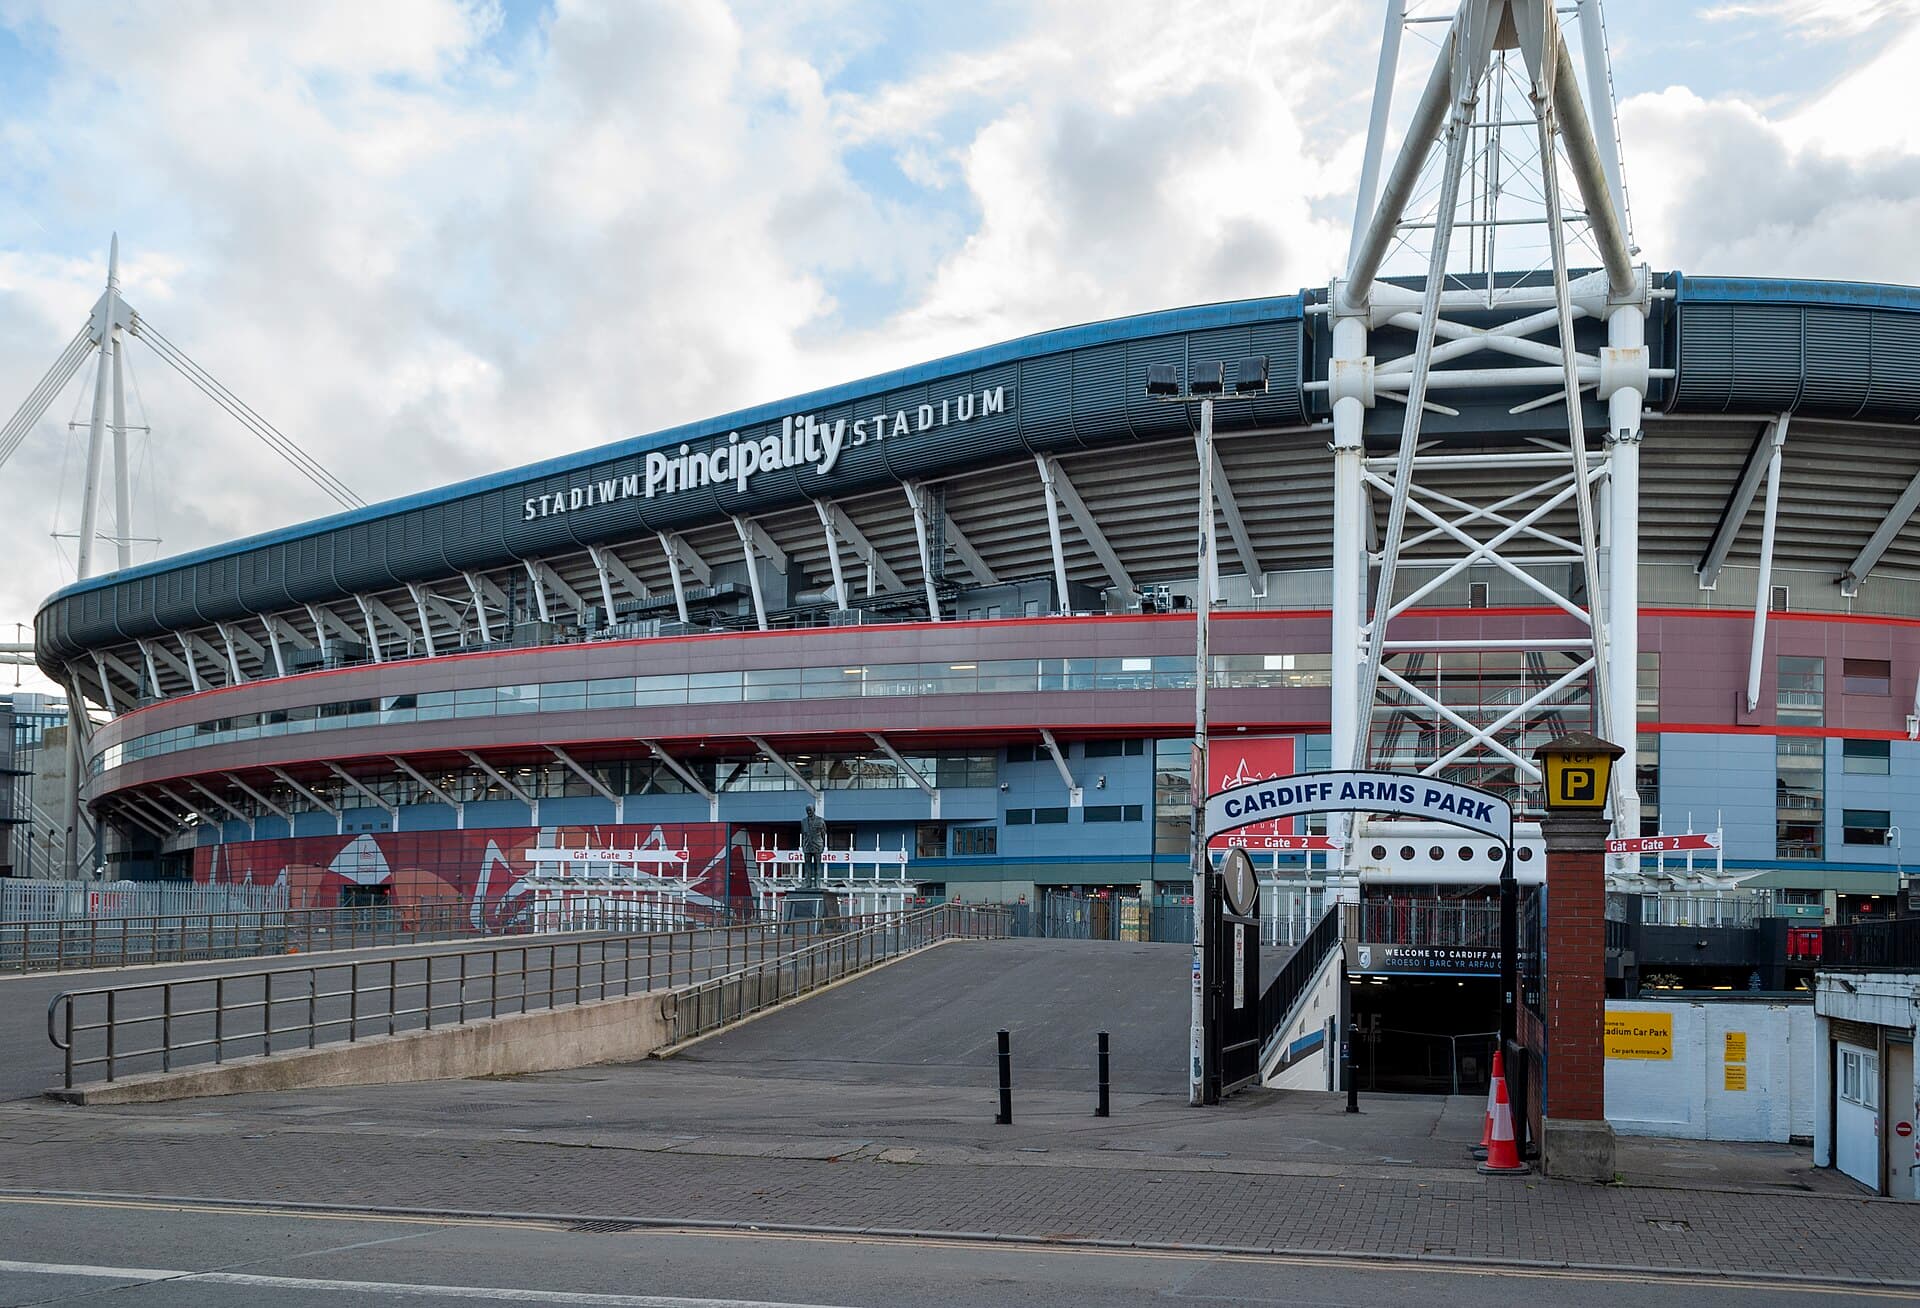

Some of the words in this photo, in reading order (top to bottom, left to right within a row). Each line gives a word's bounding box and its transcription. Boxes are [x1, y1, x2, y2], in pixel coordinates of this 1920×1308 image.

[524, 475, 639, 521] STADIWM
[646, 415, 847, 498] Principality
[853, 386, 1005, 447] STADIUM
[1563, 753, 1594, 762] NCP
[1567, 771, 1589, 798] P
[1225, 782, 1333, 818] CARDIFF
[1340, 781, 1415, 804] ARMS
[1424, 788, 1496, 824] PARK
[1264, 838, 1291, 848] Gate
[1301, 838, 1309, 848] 2
[1641, 840, 1664, 850] Gate
[1673, 838, 1680, 848] 2
[600, 851, 620, 860] Gate
[628, 851, 633, 860] 3
[822, 853, 837, 861] ate
[844, 853, 850, 861] 3
[1385, 949, 1430, 958] WELCOME
[1434, 950, 1446, 958] TO
[1449, 951, 1488, 960] CARDIFF
[1385, 959, 1420, 967] CROESO
[1430, 960, 1452, 968] BARC
[1455, 960, 1466, 968] YR
[1468, 960, 1494, 968] ARFAU
[1605, 1028, 1632, 1036] adium
[1633, 1028, 1647, 1036] Car
[1649, 1028, 1669, 1037] Park
